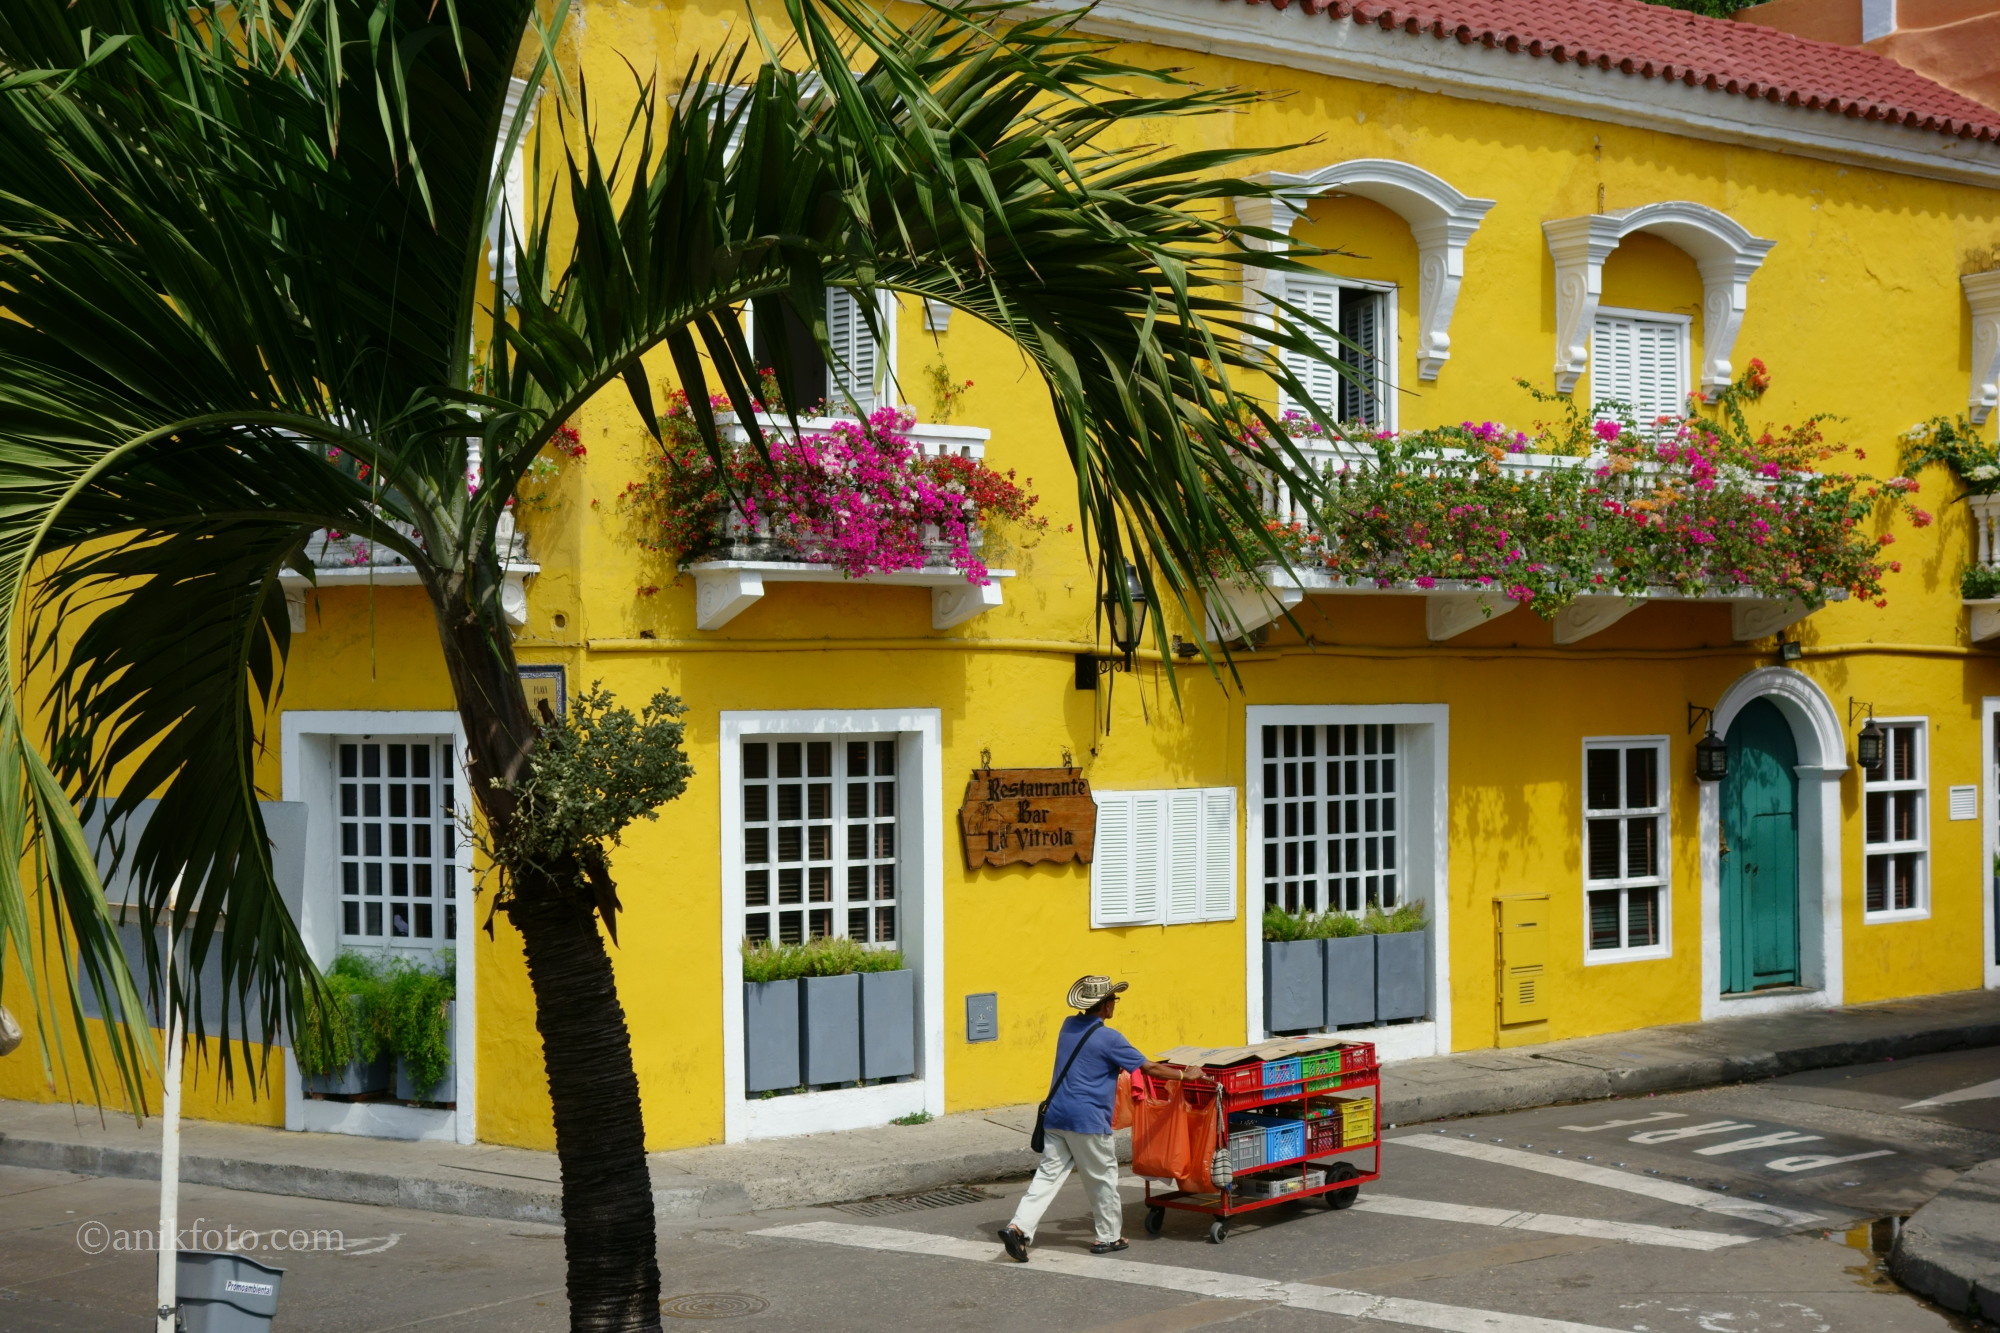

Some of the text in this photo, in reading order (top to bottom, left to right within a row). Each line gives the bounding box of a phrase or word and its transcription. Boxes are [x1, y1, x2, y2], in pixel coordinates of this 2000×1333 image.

[988, 778, 1086, 801] Restaurante
[1018, 800, 1049, 824] Bar
[987, 828, 1073, 852] La Vitrola
[1558, 1111, 1897, 1173] PARE
[226, 1281, 272, 1297] Promoambiental
